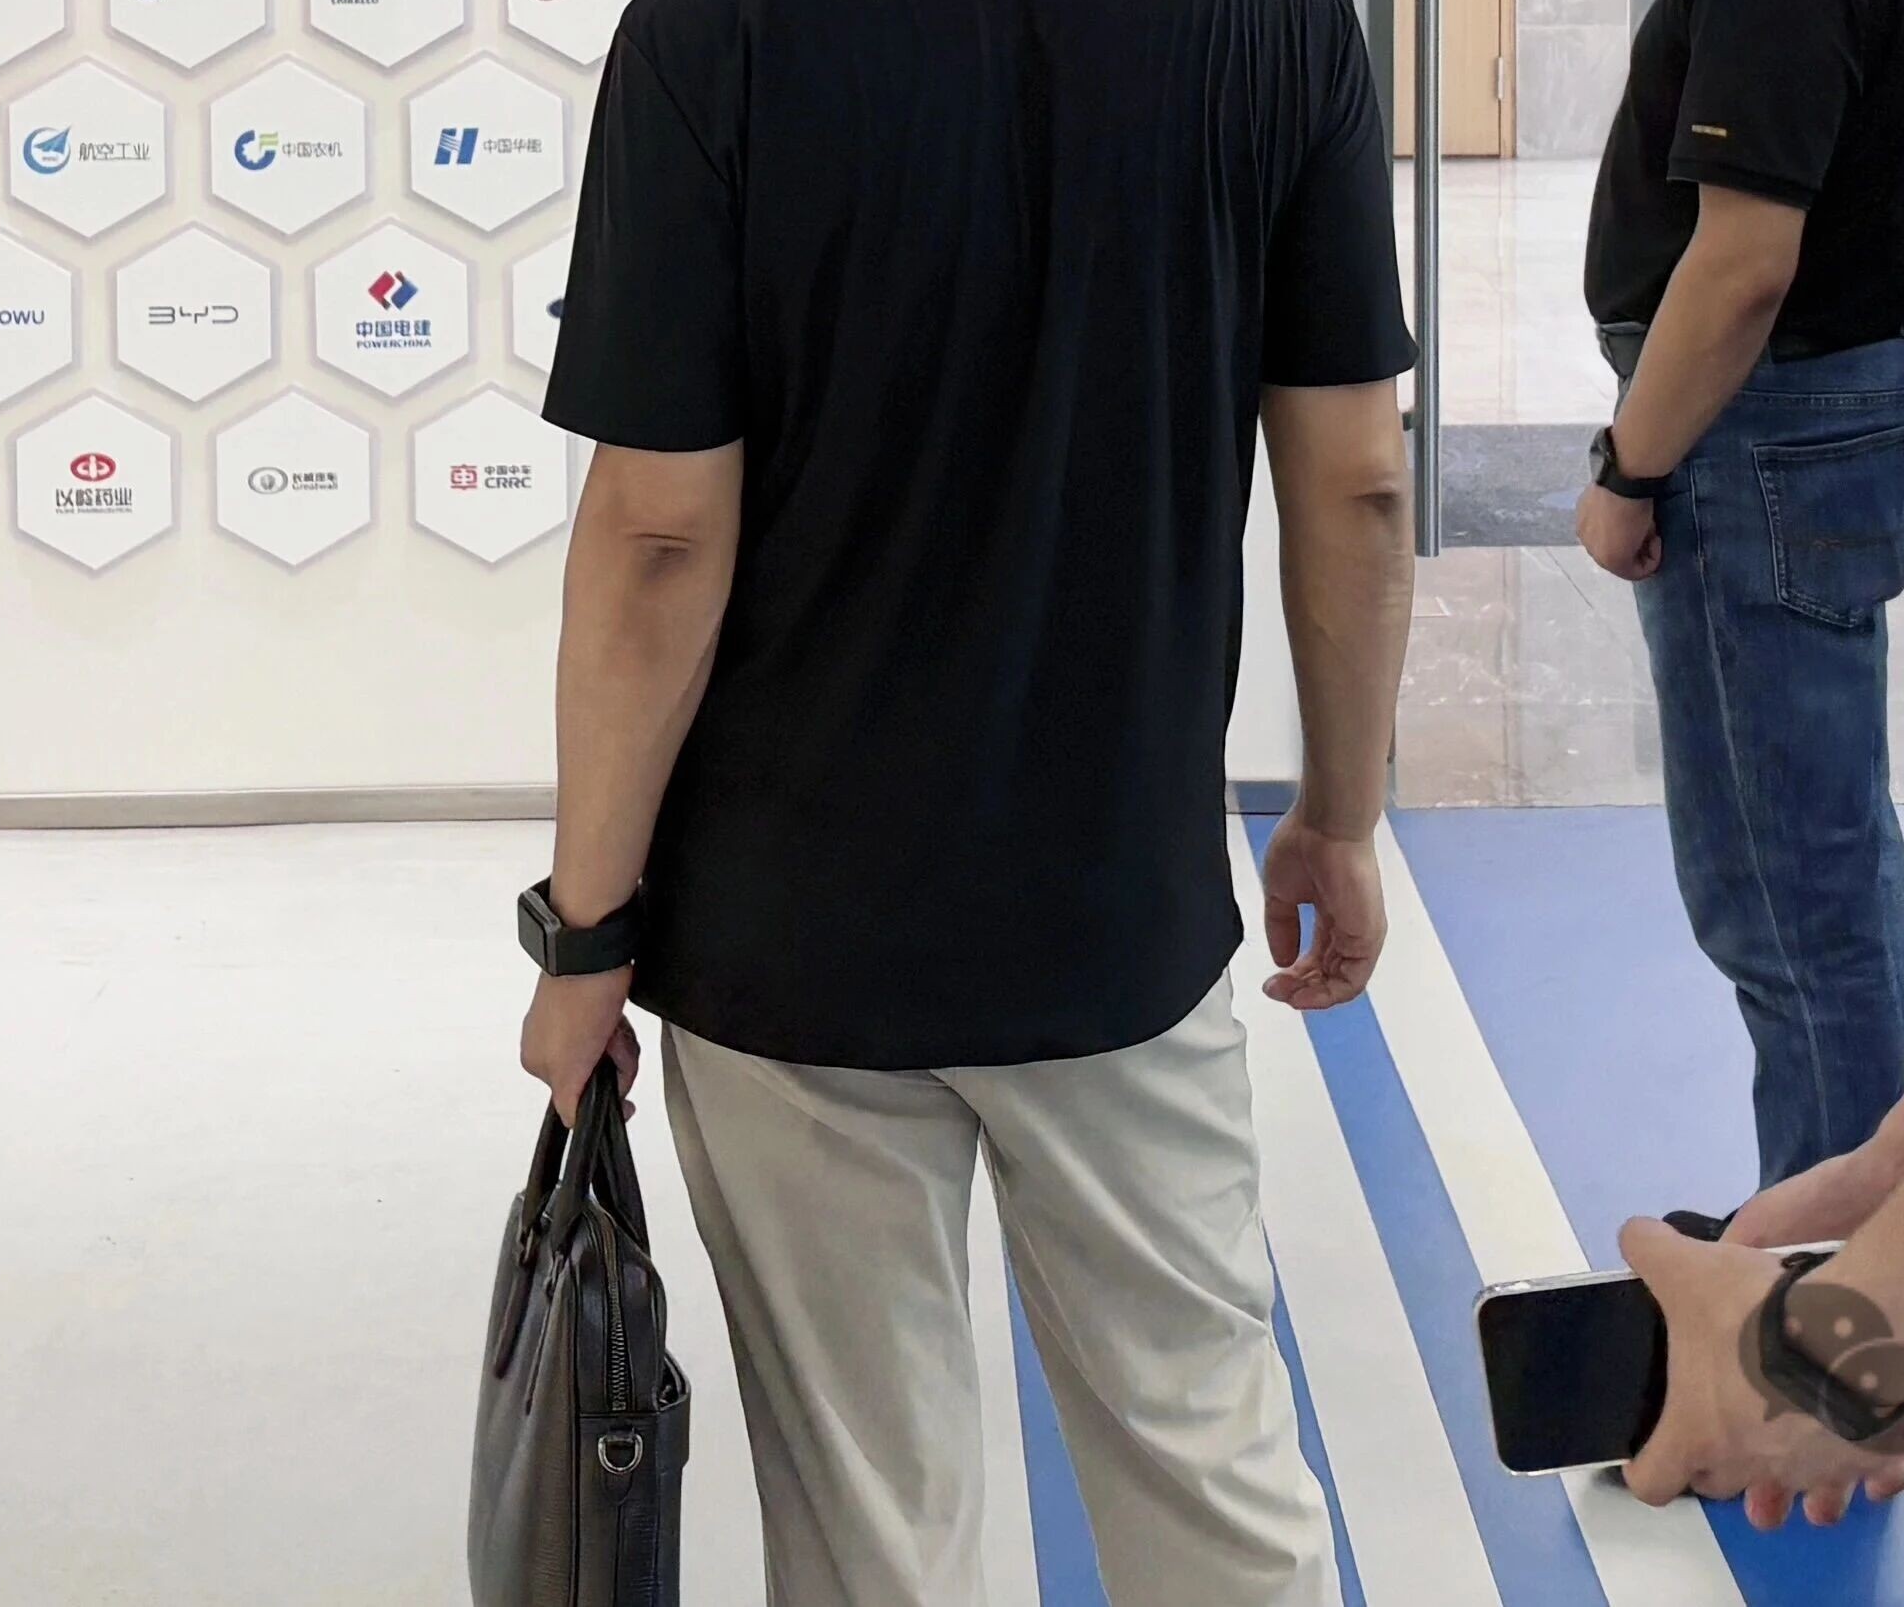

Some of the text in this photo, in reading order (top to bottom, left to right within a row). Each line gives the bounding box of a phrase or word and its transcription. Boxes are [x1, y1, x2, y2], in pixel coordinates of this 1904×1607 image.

[78, 141, 151, 161] 航空工业
[282, 140, 343, 159] 中国农机
[482, 137, 543, 154] 中国华能
[148, 305, 239, 325] BYD
[356, 320, 432, 338] 中国电建
[356, 339, 432, 349] POWERCHINA
[484, 465, 532, 476] 中国中车
[484, 477, 532, 489] CRRC
[55, 487, 133, 507] 以岭药业
